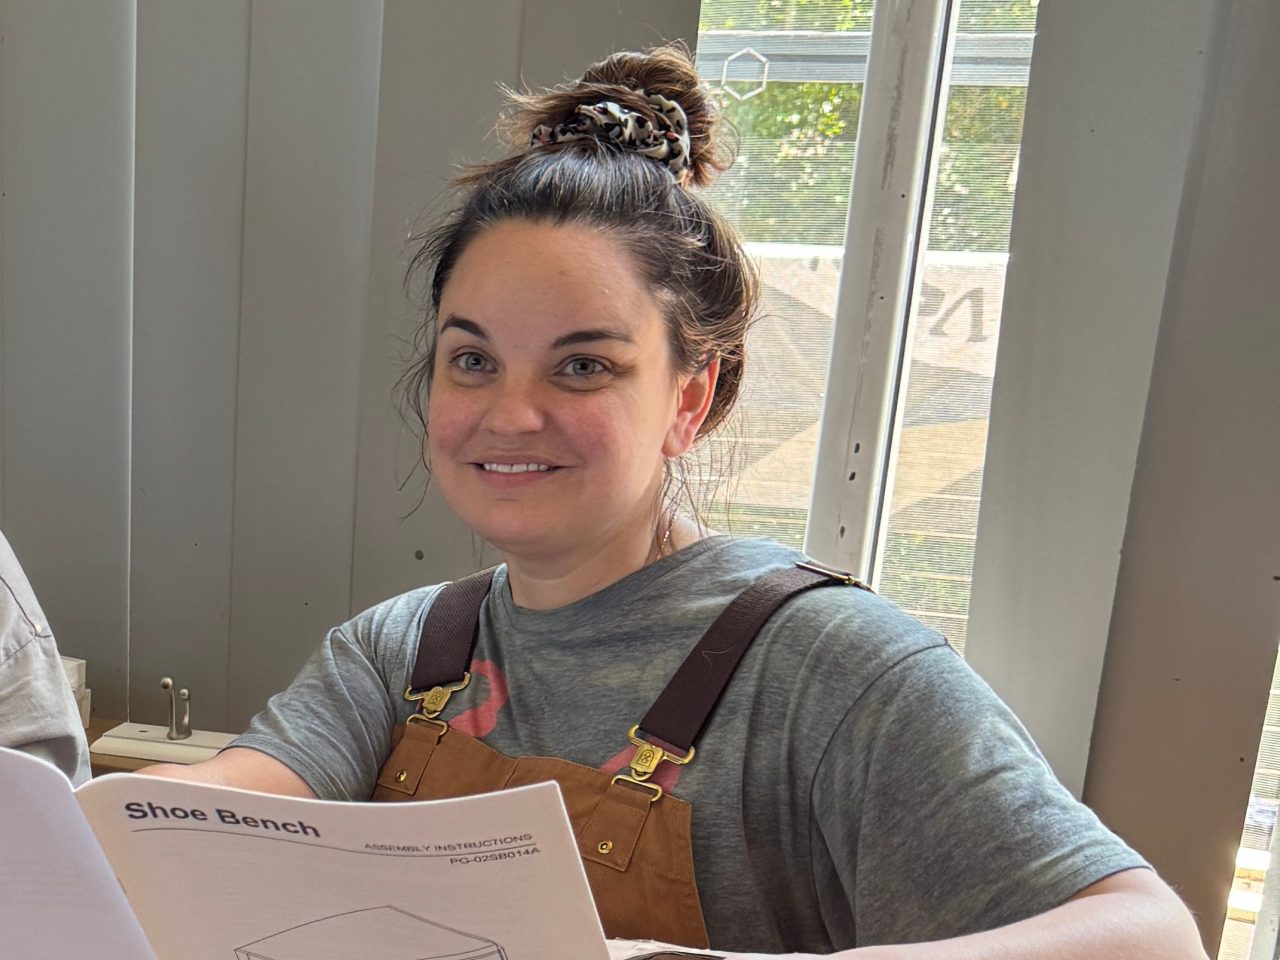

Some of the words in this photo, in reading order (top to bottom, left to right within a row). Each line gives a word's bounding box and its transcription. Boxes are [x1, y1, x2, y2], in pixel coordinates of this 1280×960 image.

[125, 801, 208, 821] Shoe
[215, 808, 321, 838] Bench
[364, 843, 430, 853] ASSEMBLY
[434, 833, 533, 851] INSTRUCTIONS
